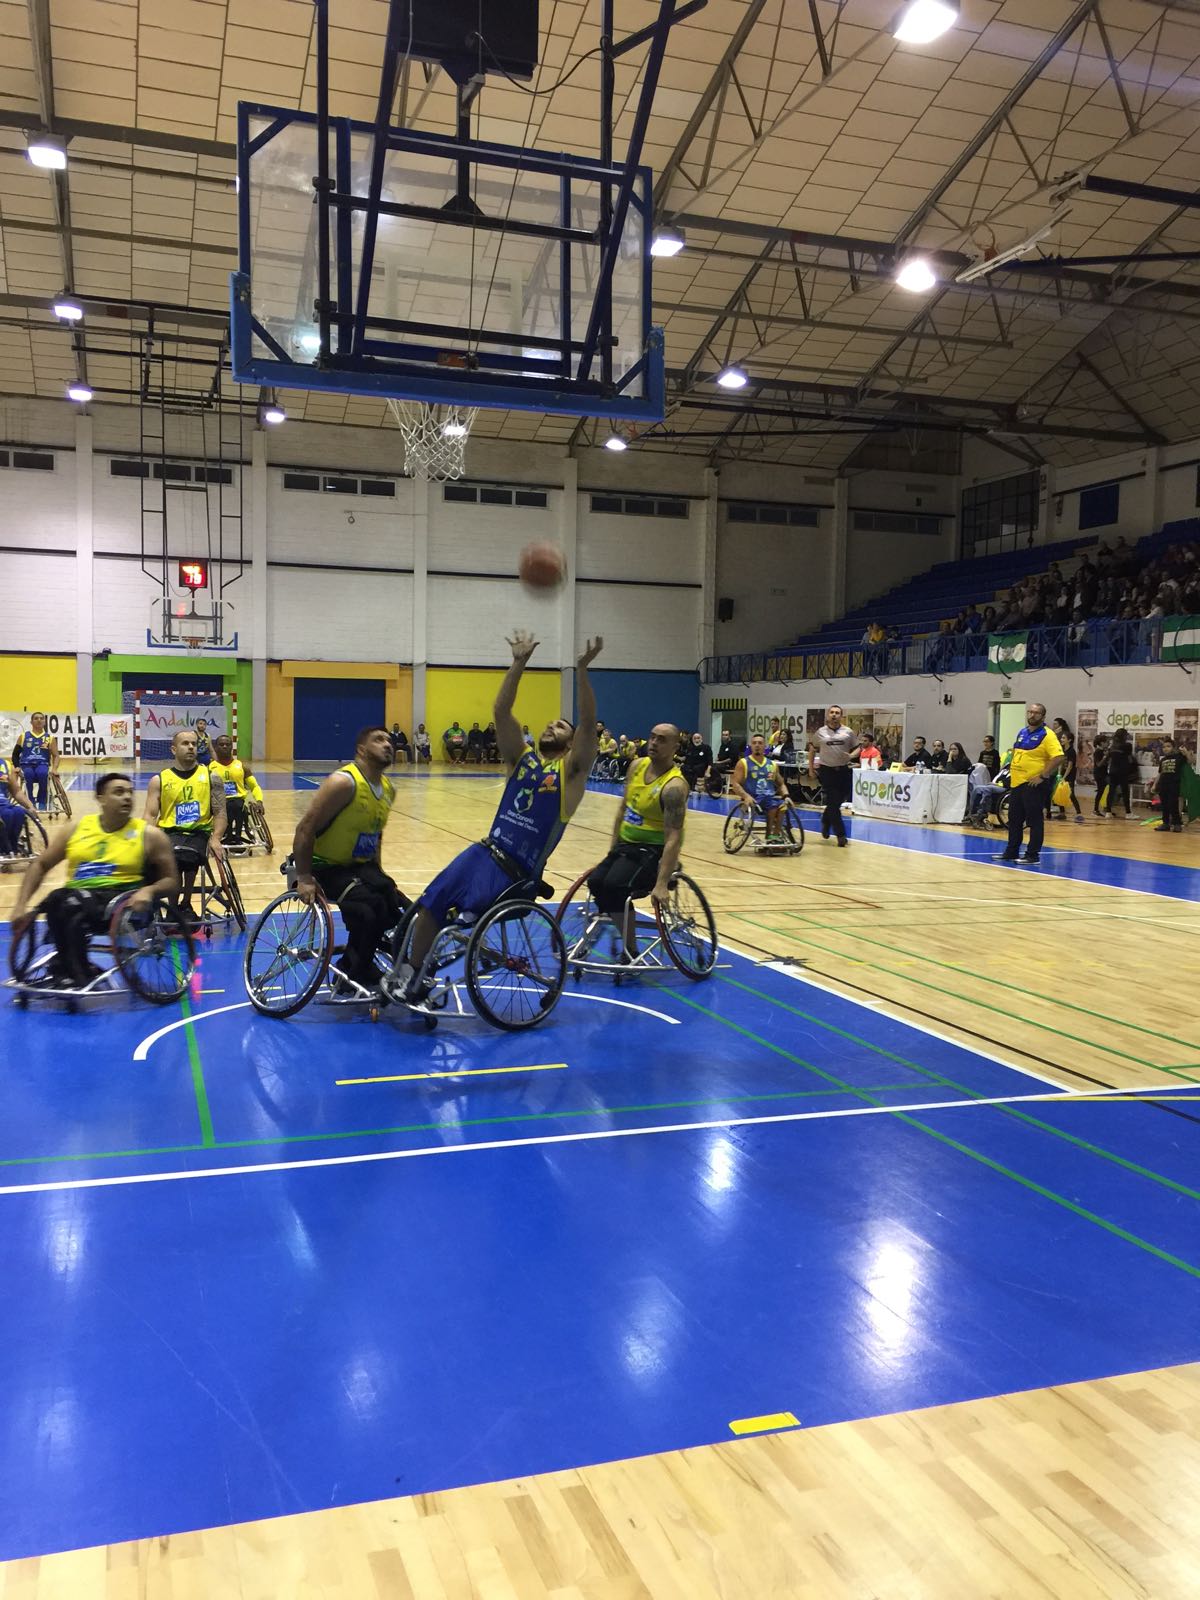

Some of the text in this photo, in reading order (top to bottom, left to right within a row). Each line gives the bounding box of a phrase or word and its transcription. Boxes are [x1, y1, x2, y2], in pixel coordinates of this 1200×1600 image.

[63, 716, 73, 734] A
[78, 716, 96, 734] LA
[145, 708, 220, 729] Andalua
[749, 707, 803, 736] deprtes
[1107, 709, 1164, 729] deportes
[183, 785, 194, 801] 12
[855, 773, 911, 806] deportes
